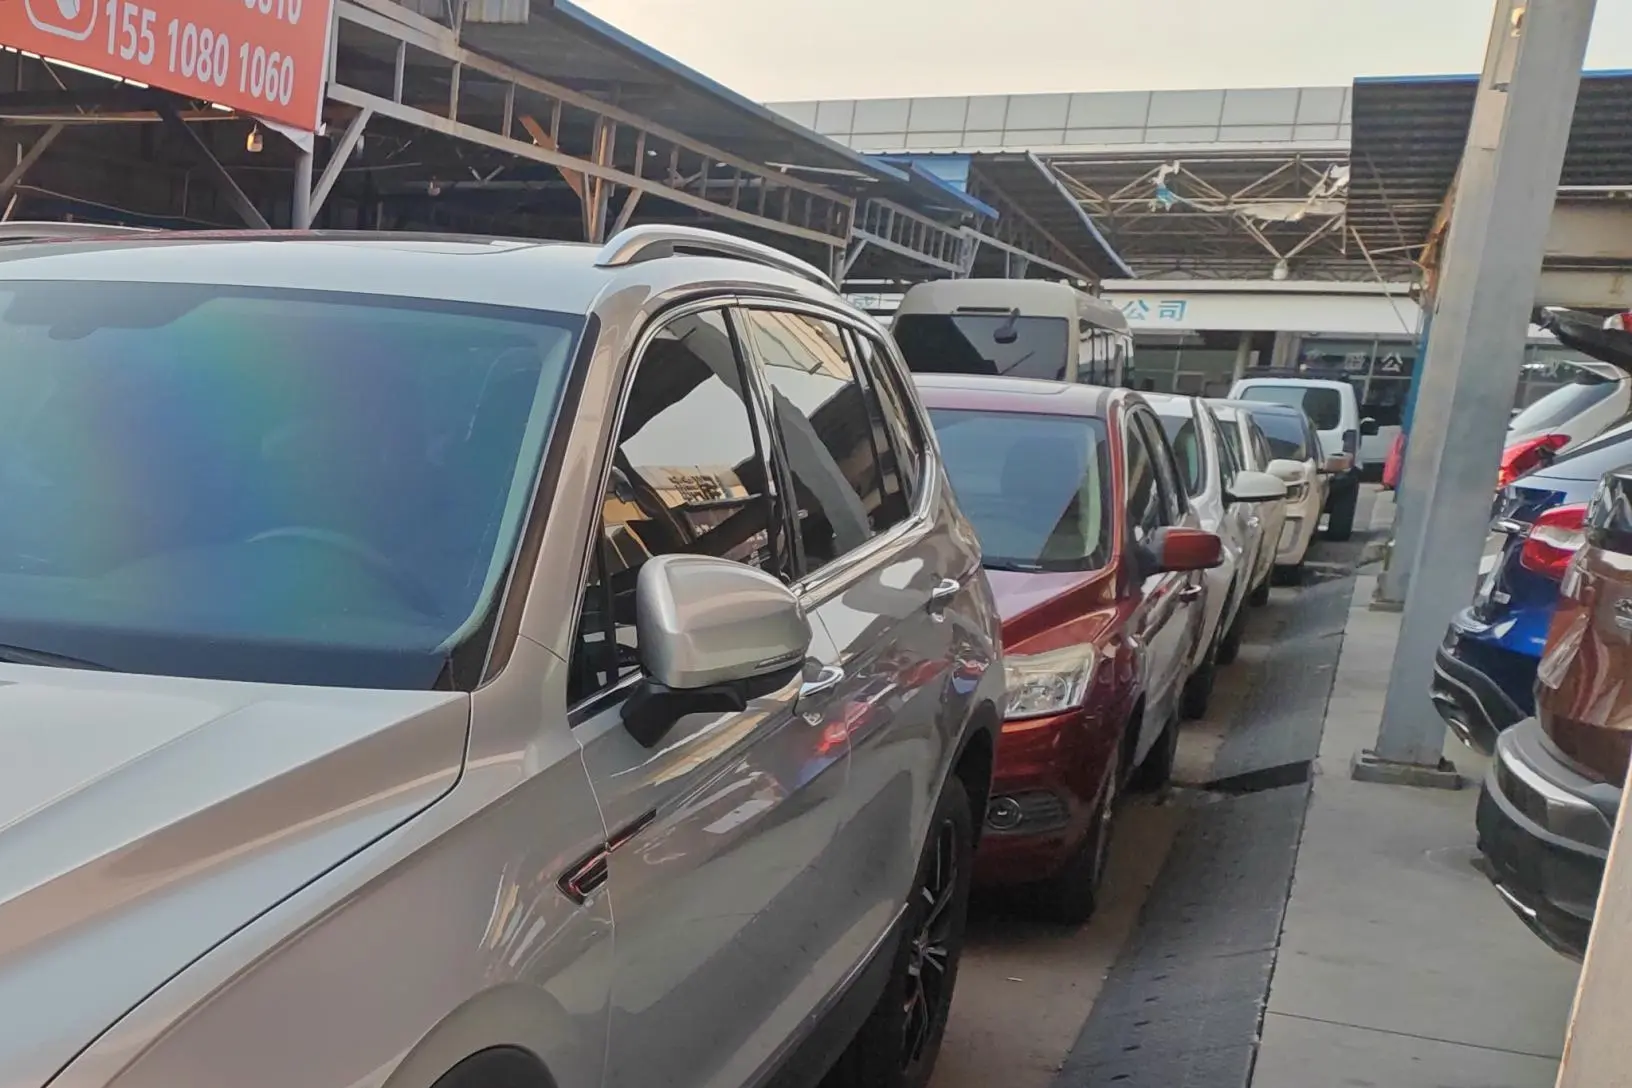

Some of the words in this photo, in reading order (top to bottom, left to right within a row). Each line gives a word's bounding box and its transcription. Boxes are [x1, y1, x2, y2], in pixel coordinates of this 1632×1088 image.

[106, 0, 157, 65] 155
[168, 18, 230, 87] 1080
[239, 42, 294, 106] 1060
[1122, 299, 1187, 321] 公司
